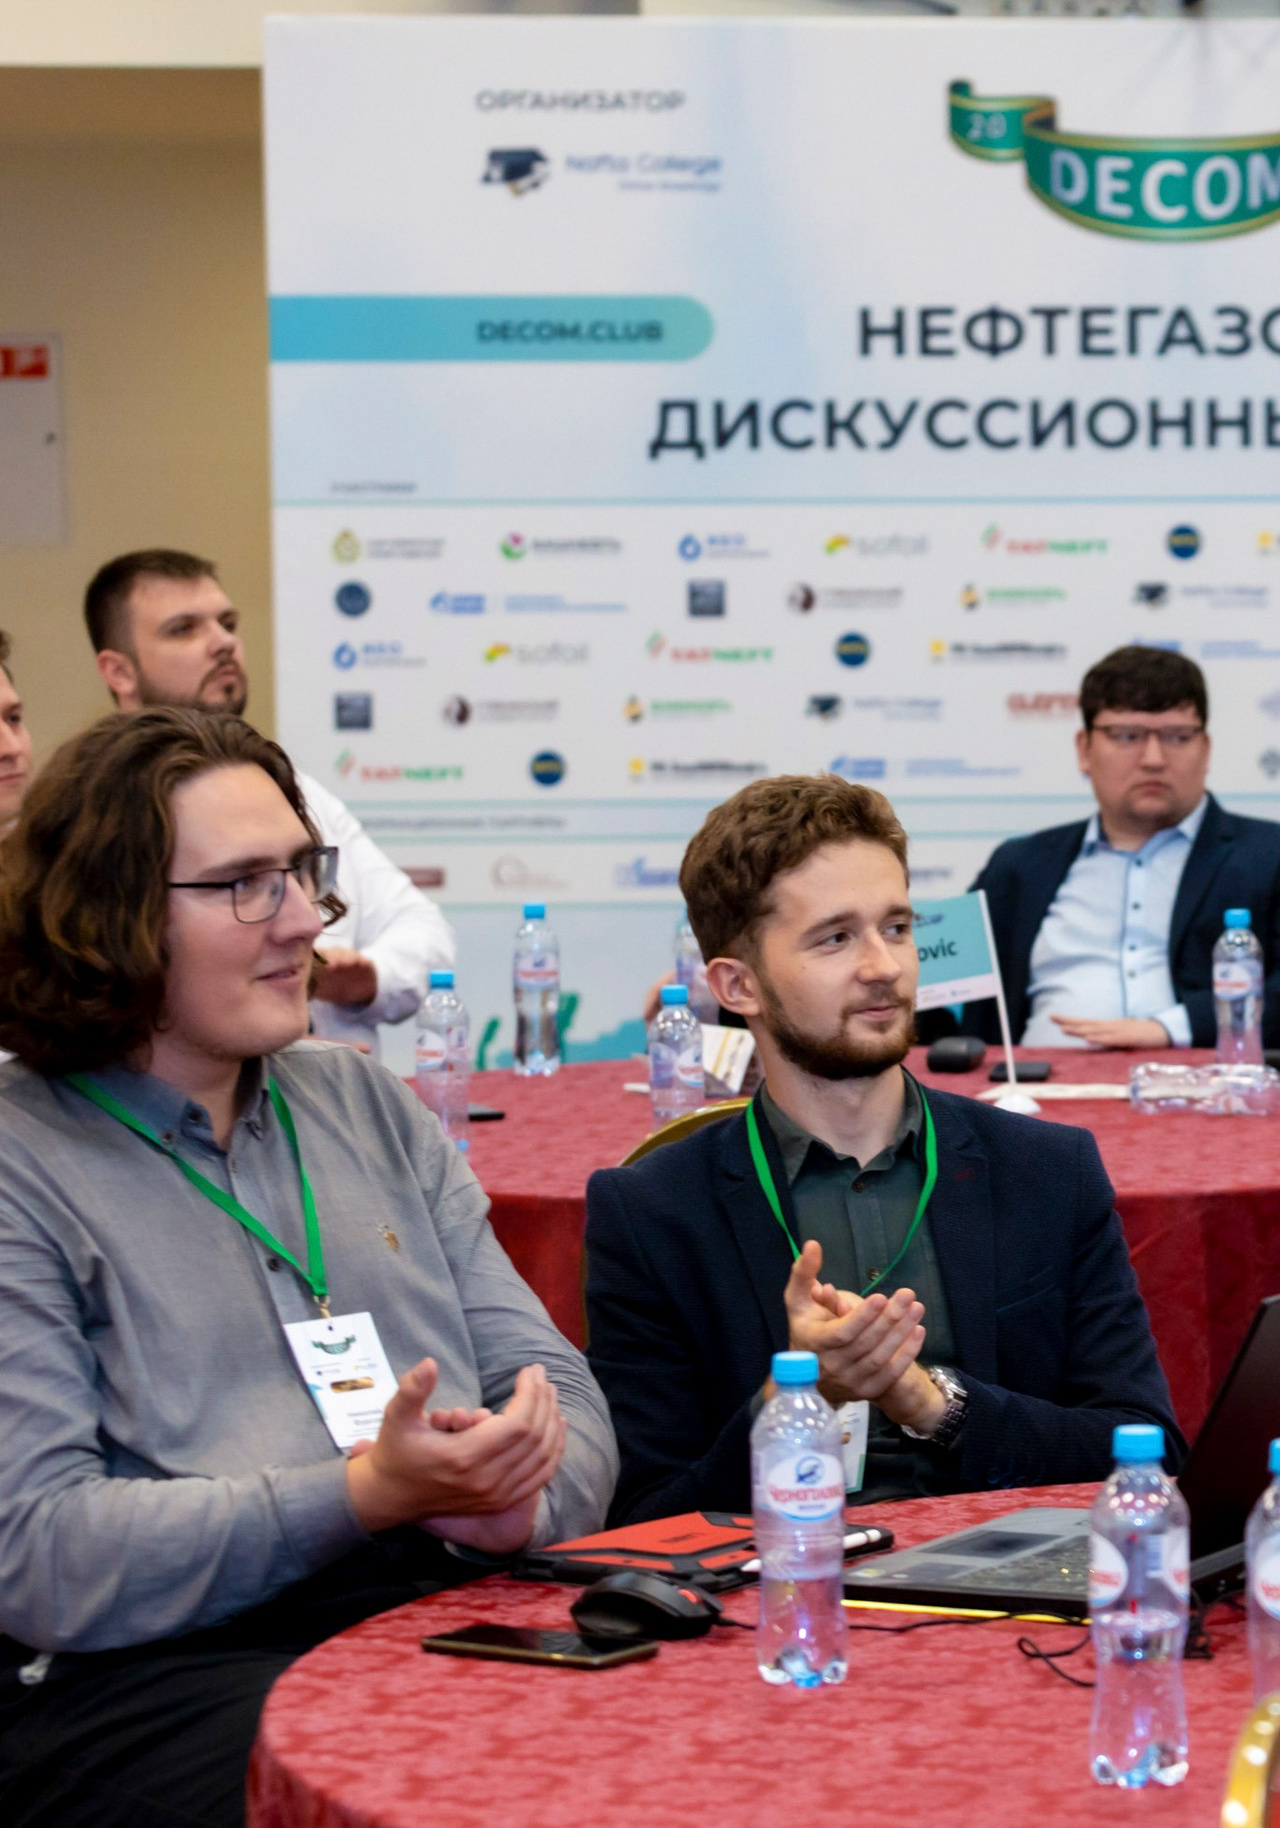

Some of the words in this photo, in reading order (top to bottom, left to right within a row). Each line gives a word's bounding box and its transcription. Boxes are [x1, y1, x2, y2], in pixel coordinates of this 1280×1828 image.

[475, 89, 686, 112] ОРГАНИЗАТОР
[966, 112, 1008, 141] 20
[476, 320, 664, 343] DECOM.CLUB
[918, 939, 958, 963] ovic
